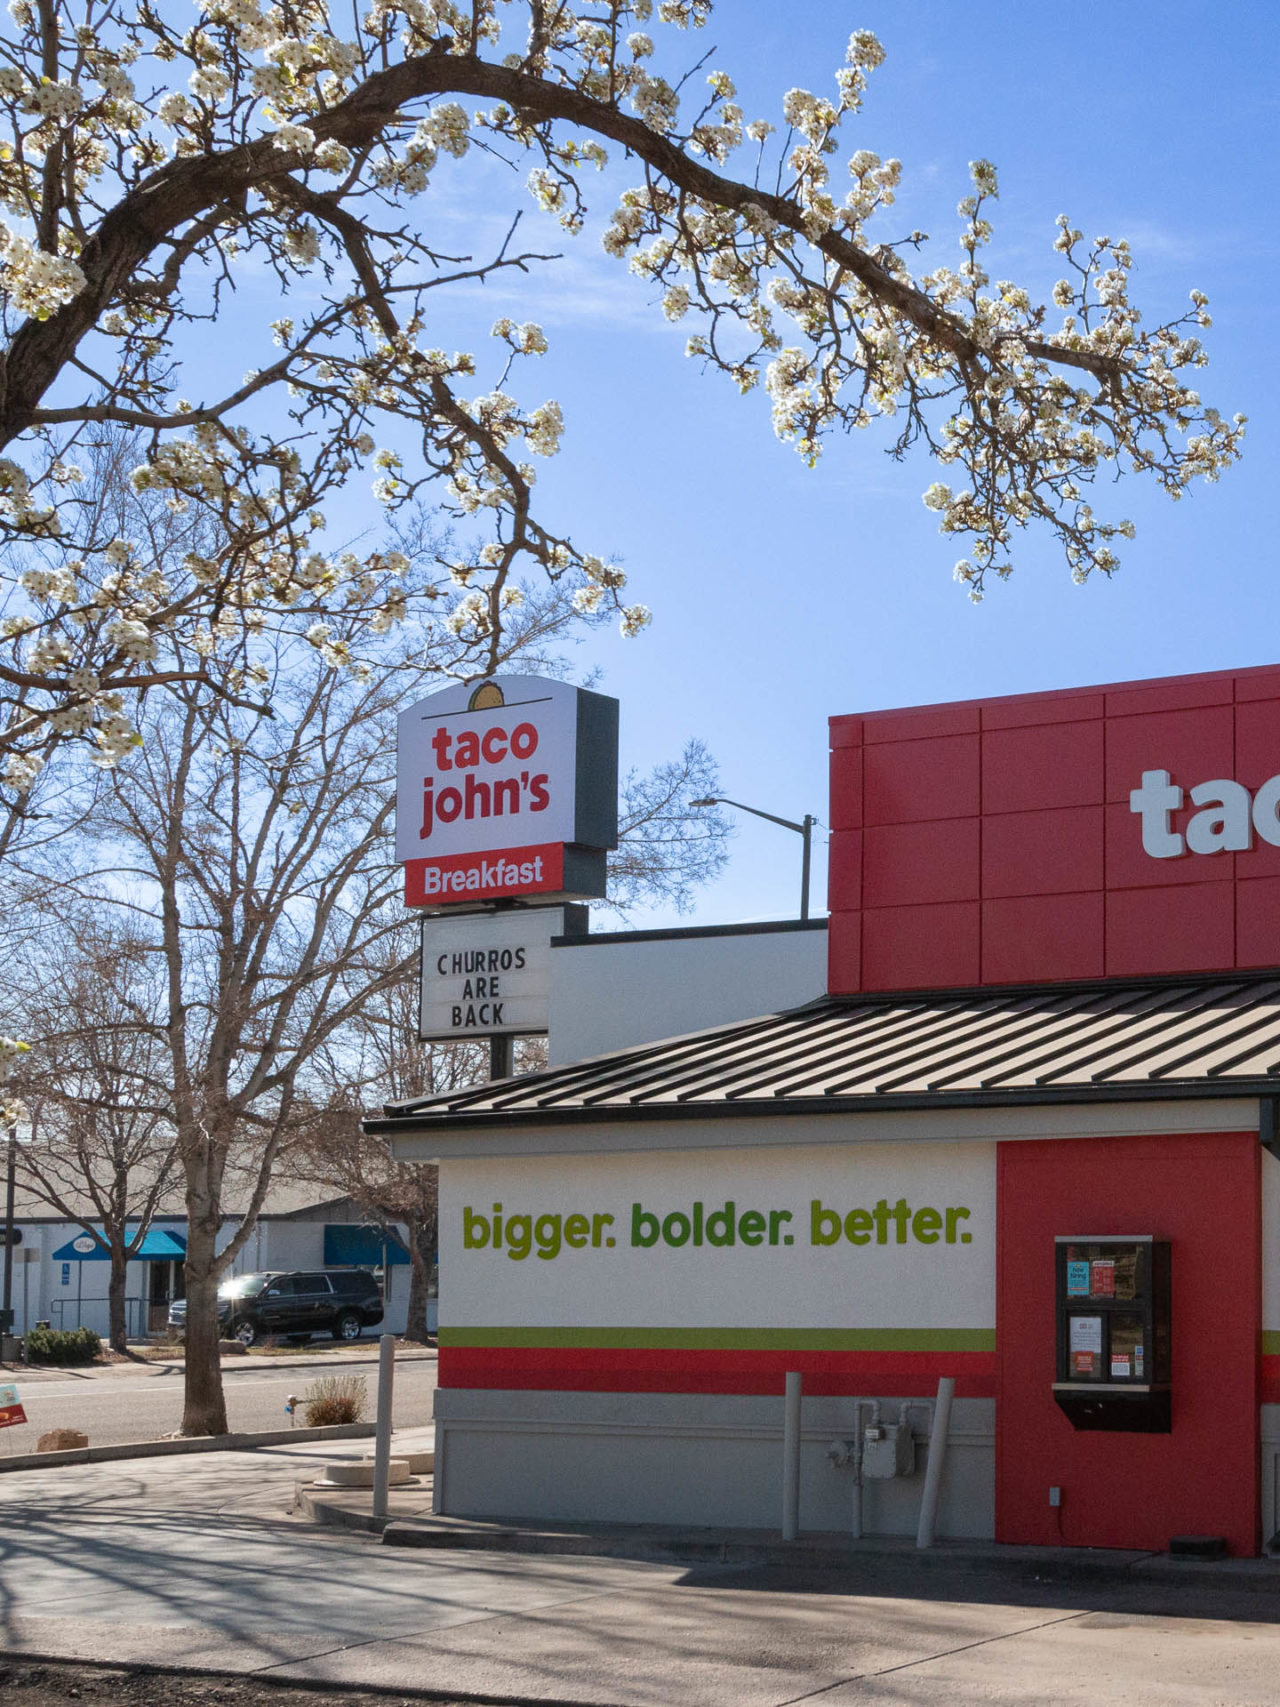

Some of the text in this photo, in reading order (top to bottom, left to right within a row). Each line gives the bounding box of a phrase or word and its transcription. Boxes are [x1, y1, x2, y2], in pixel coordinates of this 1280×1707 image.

[432, 722, 539, 771] taco
[419, 771, 551, 840] john's
[424, 855, 544, 894] Breakfast
[437, 947, 526, 975] CHURROS
[462, 976, 500, 1001] ARE
[452, 1003, 504, 1027] BACK
[463, 1198, 973, 1261] bigger. bolder. better.
